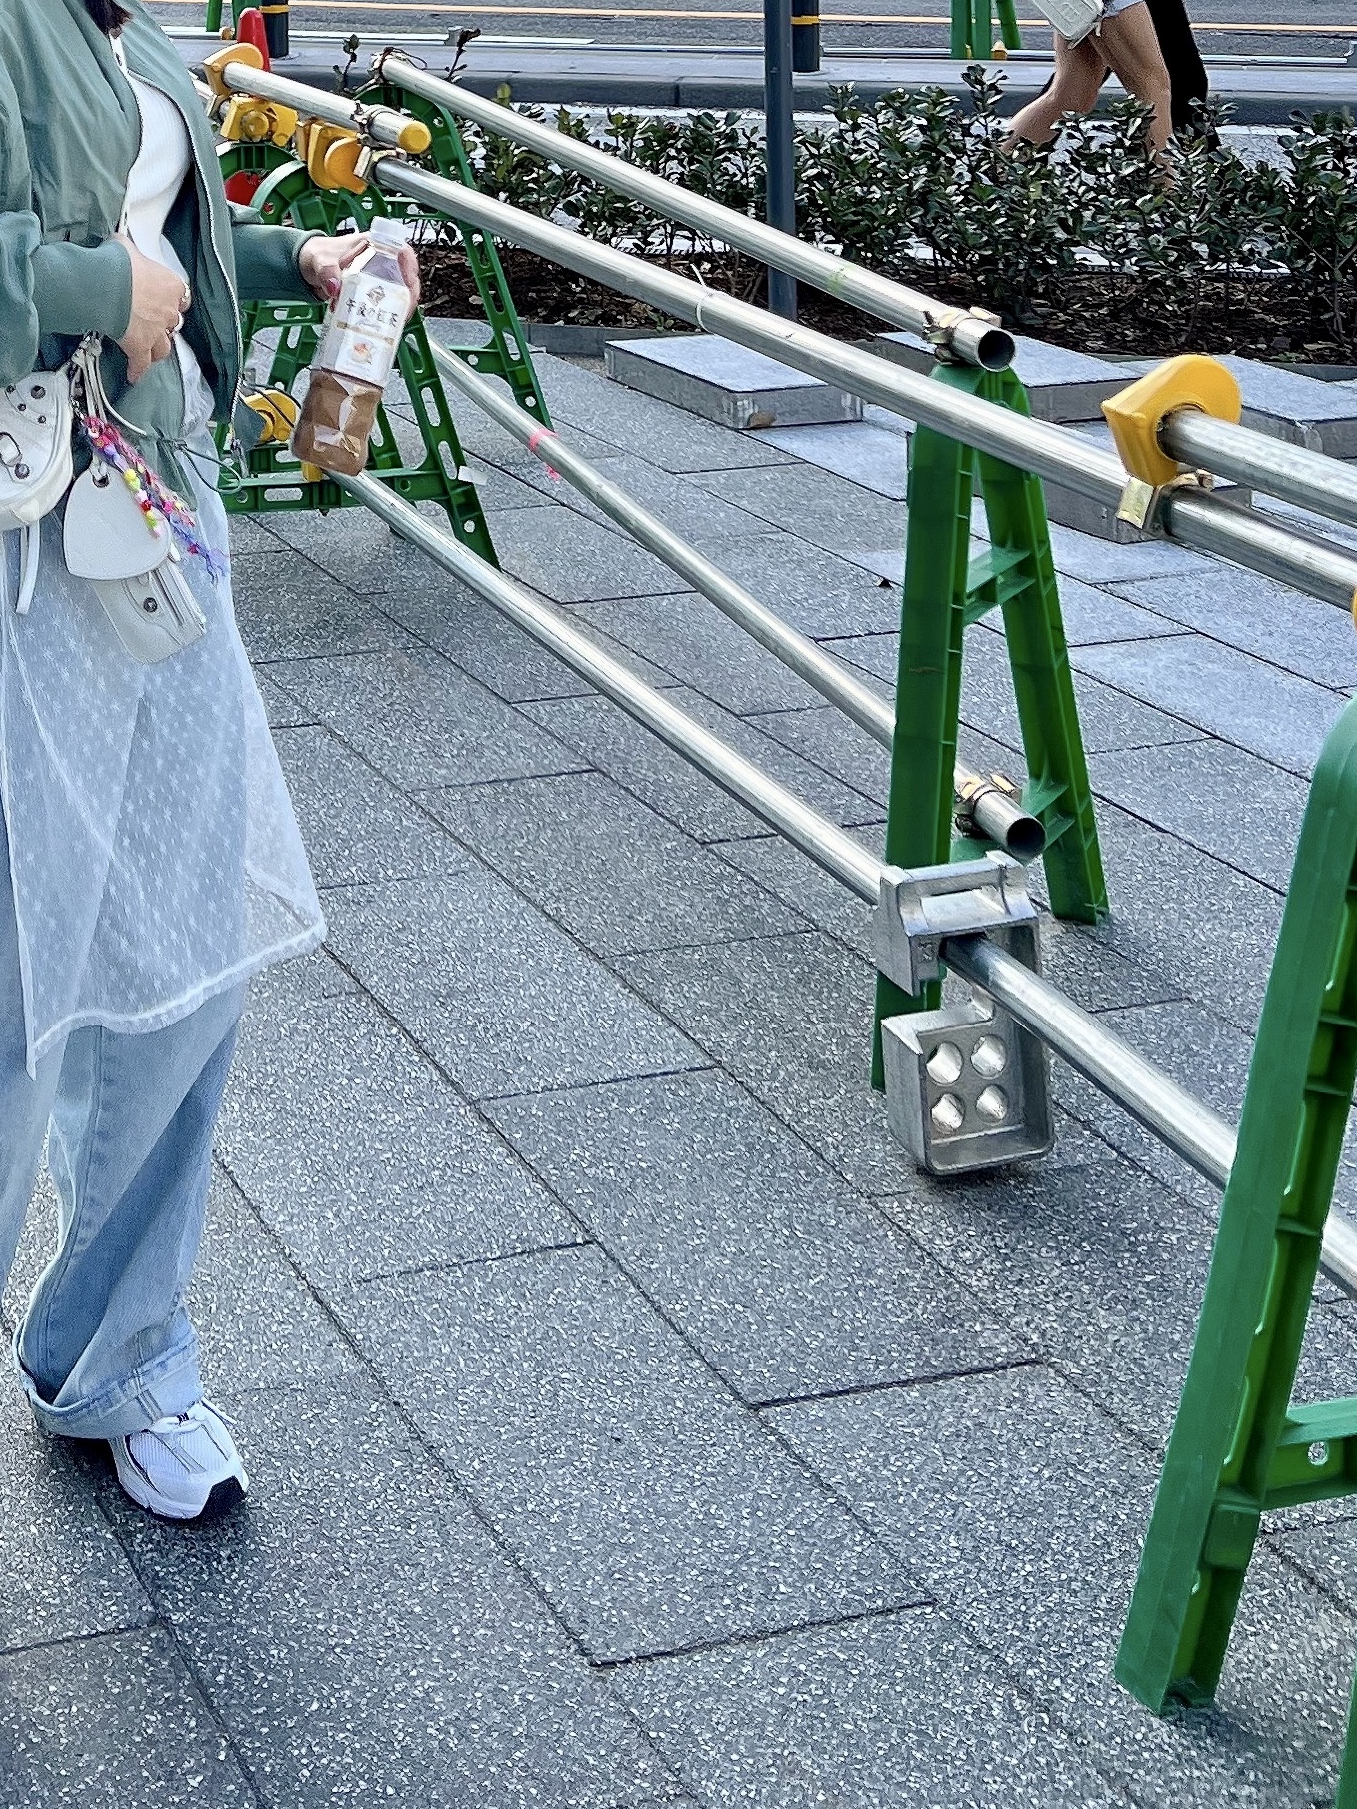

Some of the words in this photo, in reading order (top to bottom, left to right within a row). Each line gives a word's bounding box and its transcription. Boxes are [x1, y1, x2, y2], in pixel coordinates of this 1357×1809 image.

[345, 297, 398, 328] 午後の紅茶
